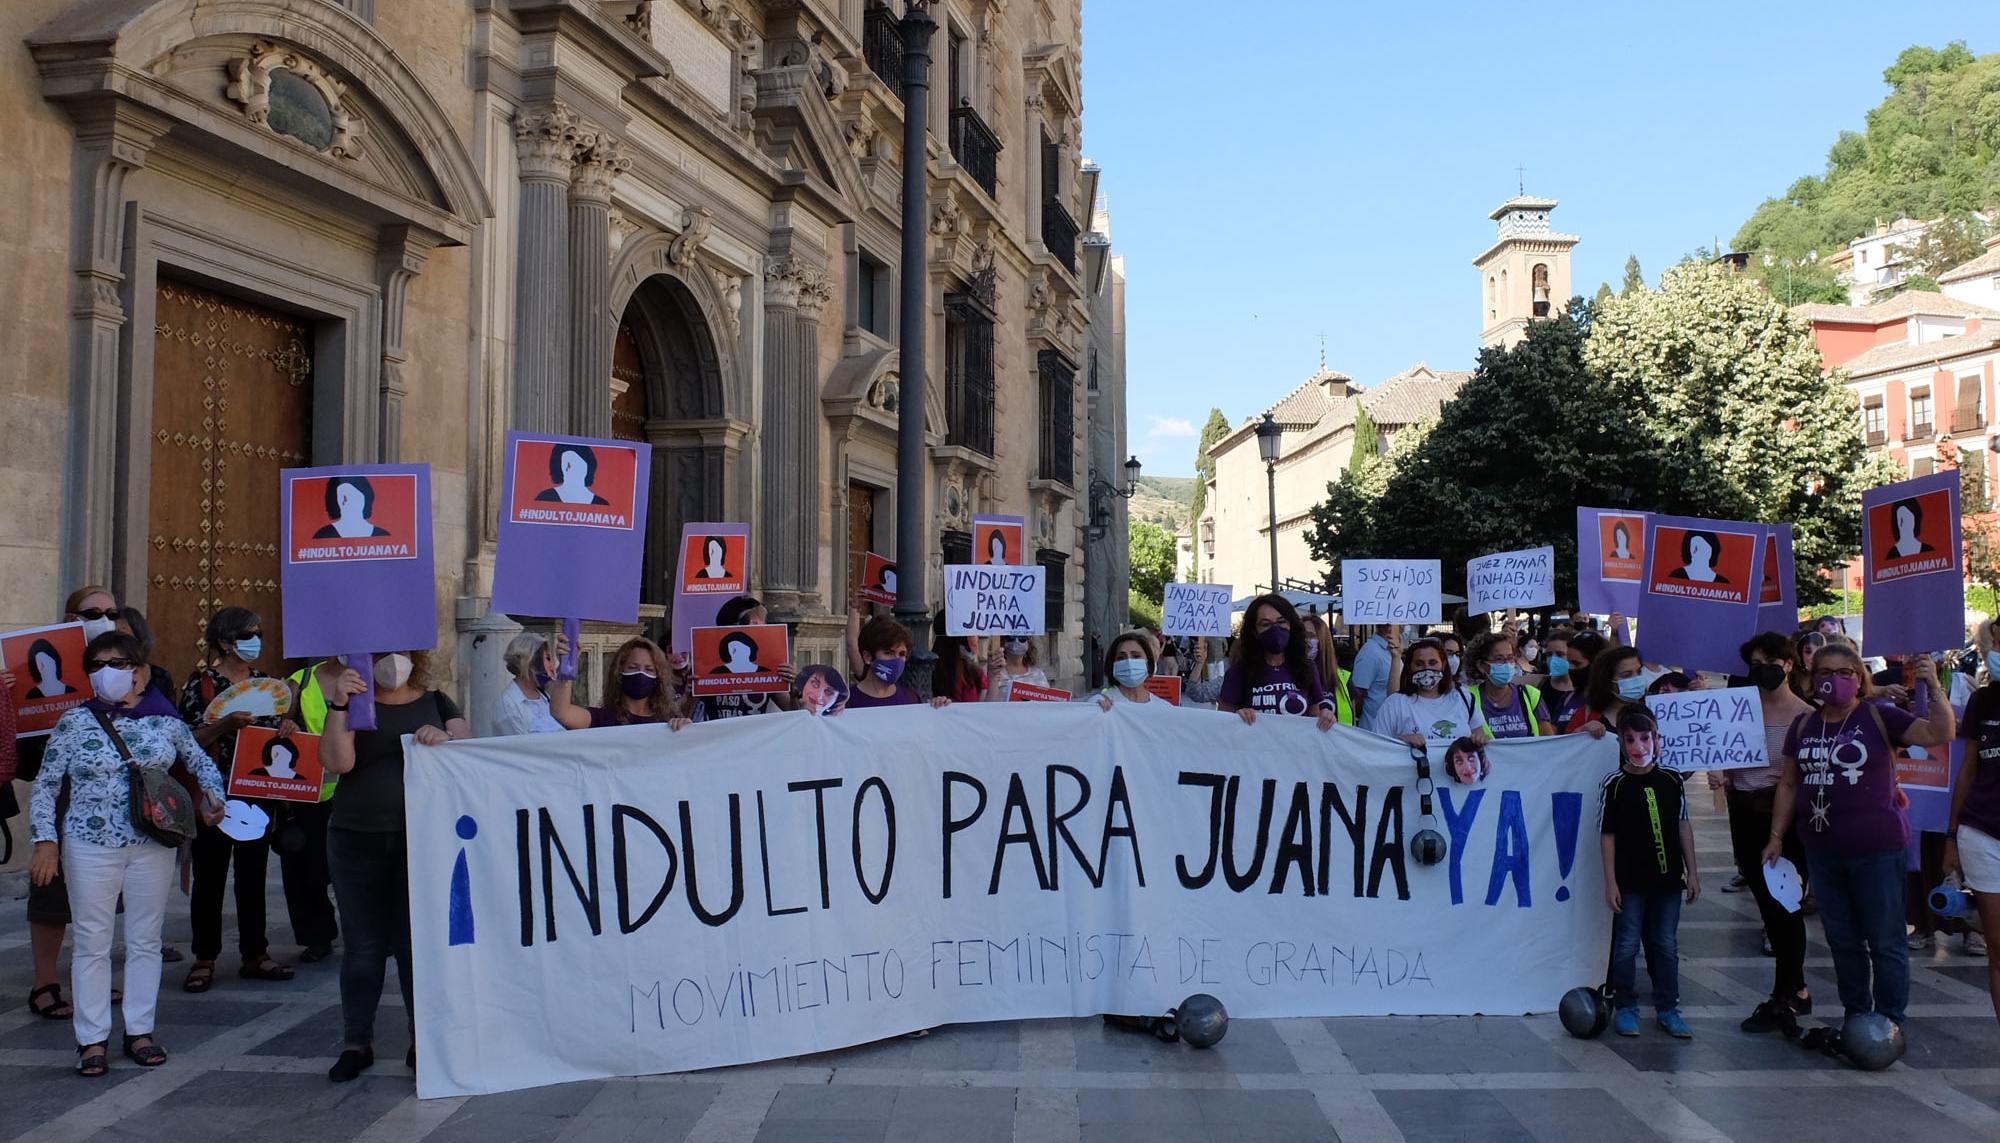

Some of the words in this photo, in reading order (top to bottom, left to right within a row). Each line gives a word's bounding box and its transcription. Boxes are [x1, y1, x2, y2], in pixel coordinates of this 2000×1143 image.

[519, 508, 626, 526] #INDULTOJUANAYA
[298, 543, 409, 559] #INDULTOJUANAYA
[1476, 558, 1501, 572] JUEZ
[1504, 554, 1548, 570] PIÑAR
[1876, 557, 1949, 579] #INDULTOJUANAYA
[955, 569, 1035, 593] INDULTO
[976, 591, 1021, 612] PARA
[1167, 586, 1230, 605] INDULTO
[1374, 585, 1400, 601] EN
[1654, 582, 1742, 602] #INDULTOJUANAYA
[1177, 601, 1217, 618] PARA
[1354, 599, 1431, 619] PELIGRO
[962, 610, 1031, 631] JUANA
[1167, 614, 1220, 633] JUANA
[1262, 694, 1277, 706] UN
[1654, 697, 1723, 722] BASTA
[1729, 695, 1755, 723] YA
[1687, 722, 1713, 734] DE
[1657, 731, 1747, 749] JUSTICIA
[235, 778, 318, 793] #INDULTOJUANAYA
[943, 764, 1146, 899] PARA
[1175, 771, 1411, 902] JUANA
[1437, 786, 1584, 909] YA!
[1178, 935, 1223, 986] DE
[1245, 940, 1436, 990] GRANADA
